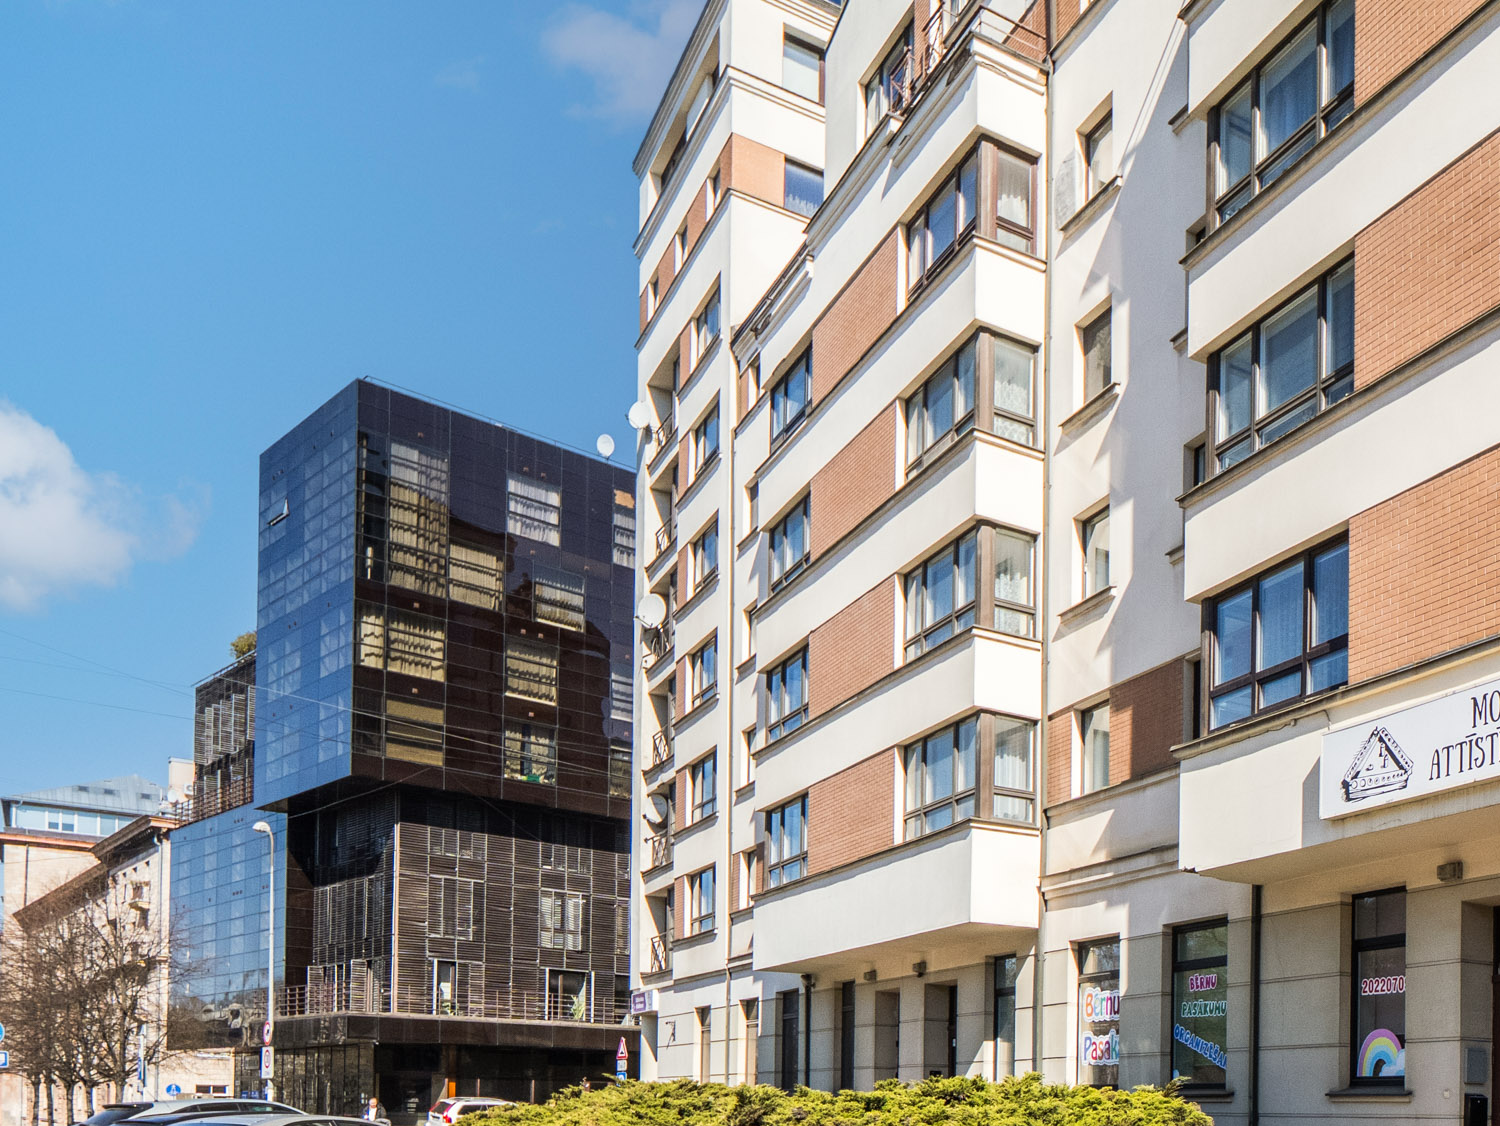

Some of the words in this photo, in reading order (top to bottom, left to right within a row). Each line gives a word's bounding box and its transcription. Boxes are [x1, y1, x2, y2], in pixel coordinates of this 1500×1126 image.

[1189, 974, 1217, 991] BĒRNU
[1181, 1000, 1227, 1017] PASĀKUMU
[1083, 1033, 1119, 1061] Pasak
